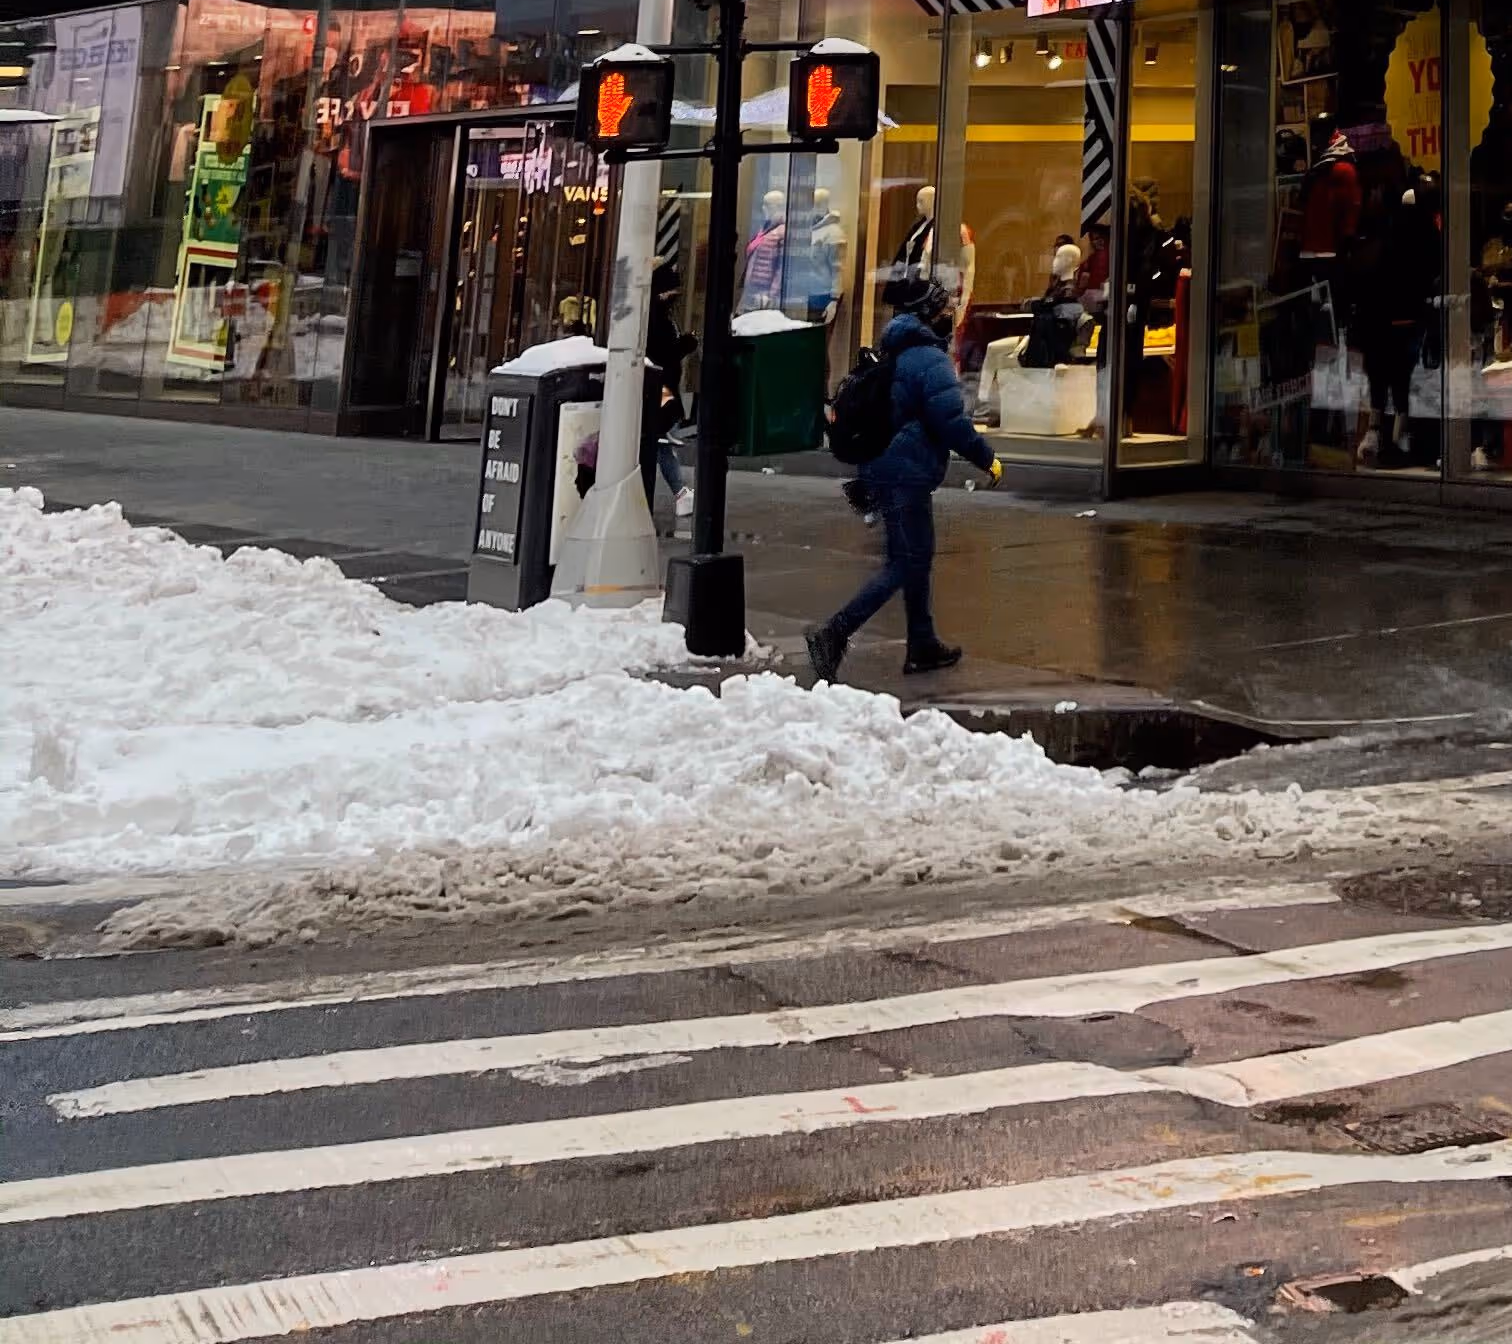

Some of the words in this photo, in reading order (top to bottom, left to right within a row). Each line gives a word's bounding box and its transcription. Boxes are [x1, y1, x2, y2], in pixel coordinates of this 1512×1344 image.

[1408, 56, 1440, 95] YO
[488, 429, 502, 449] BE
[485, 459, 520, 484] AFRAID
[482, 493, 496, 513] OF
[478, 528, 516, 553] ANYONE
